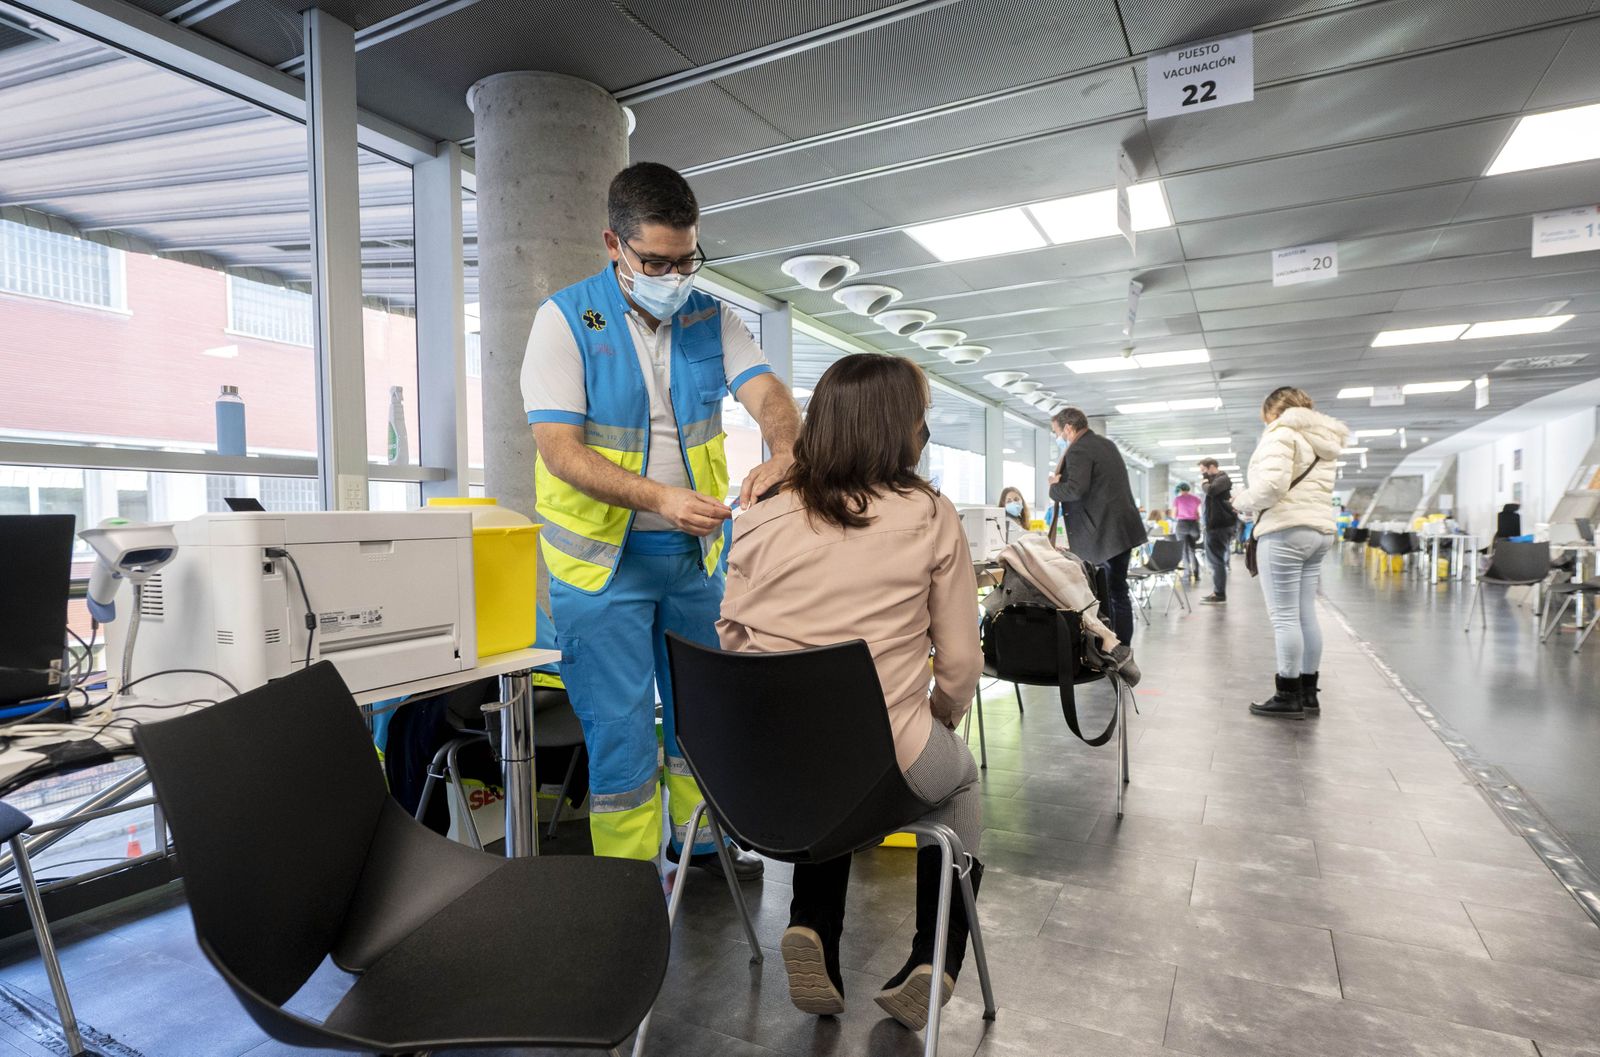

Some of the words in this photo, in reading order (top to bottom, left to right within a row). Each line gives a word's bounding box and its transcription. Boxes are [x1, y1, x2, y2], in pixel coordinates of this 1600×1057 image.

[1178, 43, 1220, 61] PUESTO
[1163, 56, 1236, 79] VACUNACIÓN
[1181, 80, 1217, 107] 22
[1312, 255, 1333, 271] 20
